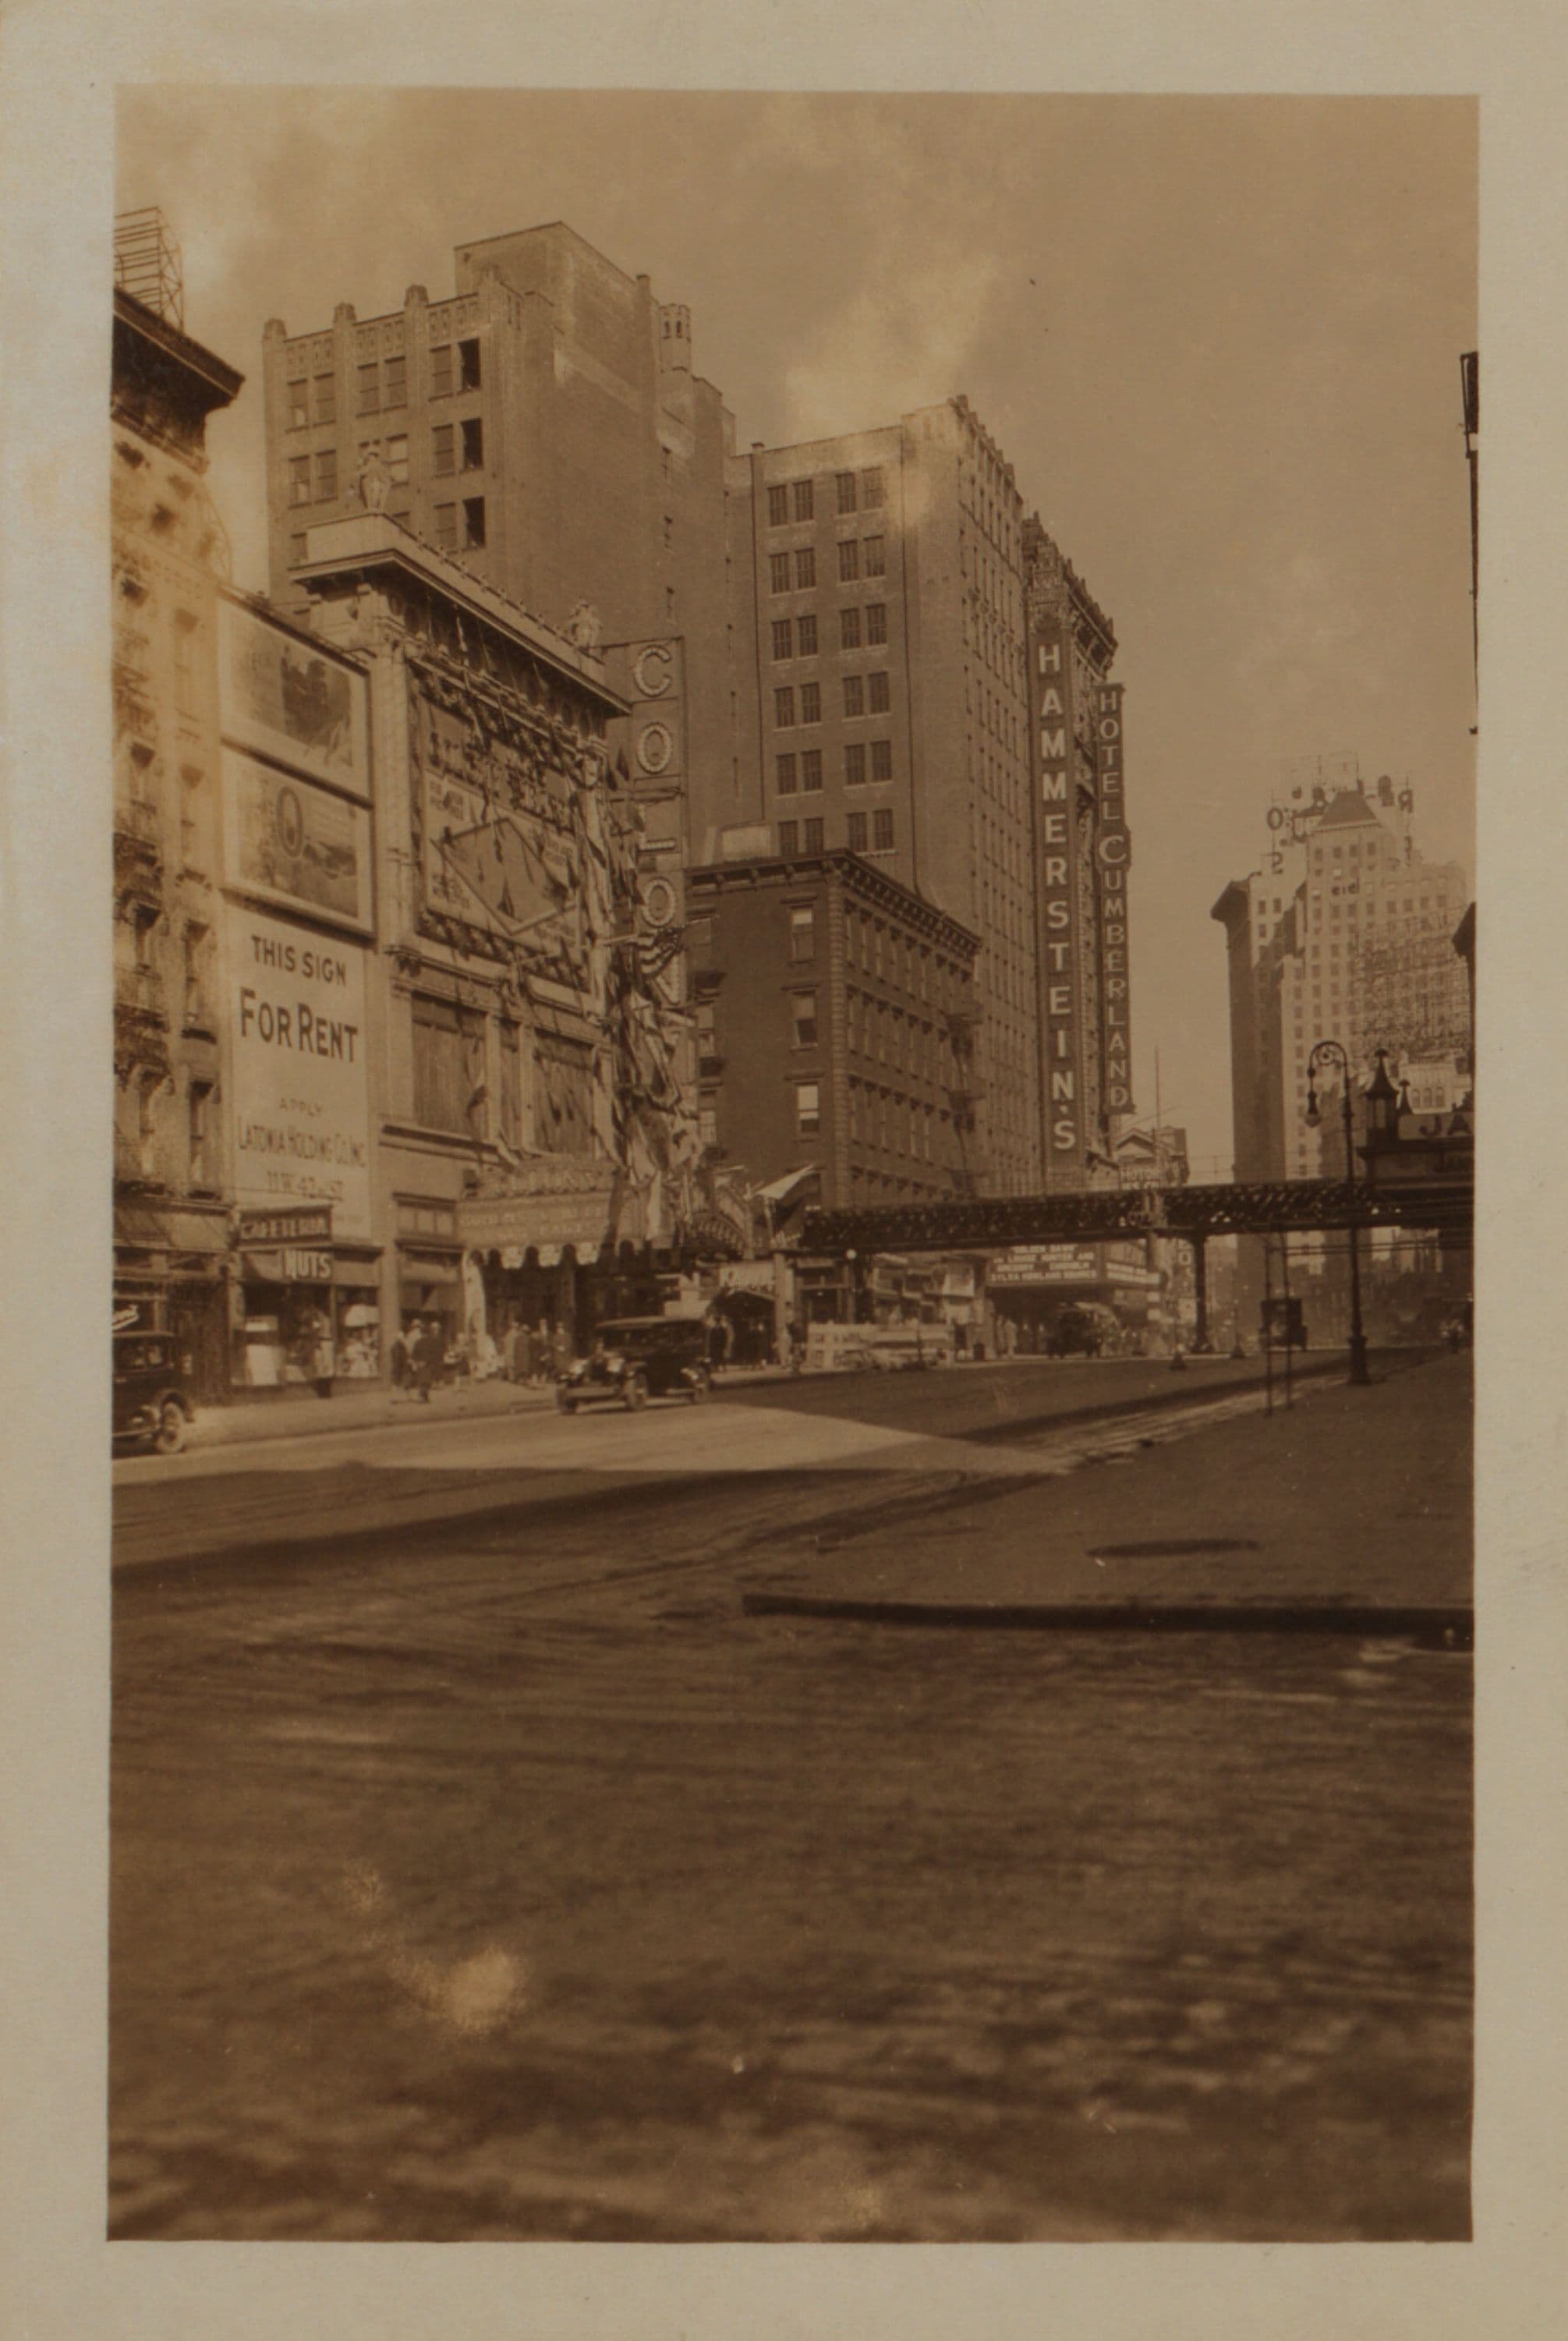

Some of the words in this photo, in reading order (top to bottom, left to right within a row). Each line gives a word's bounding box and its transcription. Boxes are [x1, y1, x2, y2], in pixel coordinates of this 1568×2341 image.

[1099, 691, 1120, 821] HOTEL
[1039, 644, 1075, 1150] HAMMERSTEIN'S
[251, 935, 296, 972] THIS
[303, 951, 346, 986] SIGN
[1099, 834, 1127, 1107] CUMBERLAND
[240, 986, 292, 1047] FOR
[298, 1002, 359, 1063] RENT
[285, 1248, 331, 1280] NUTS
